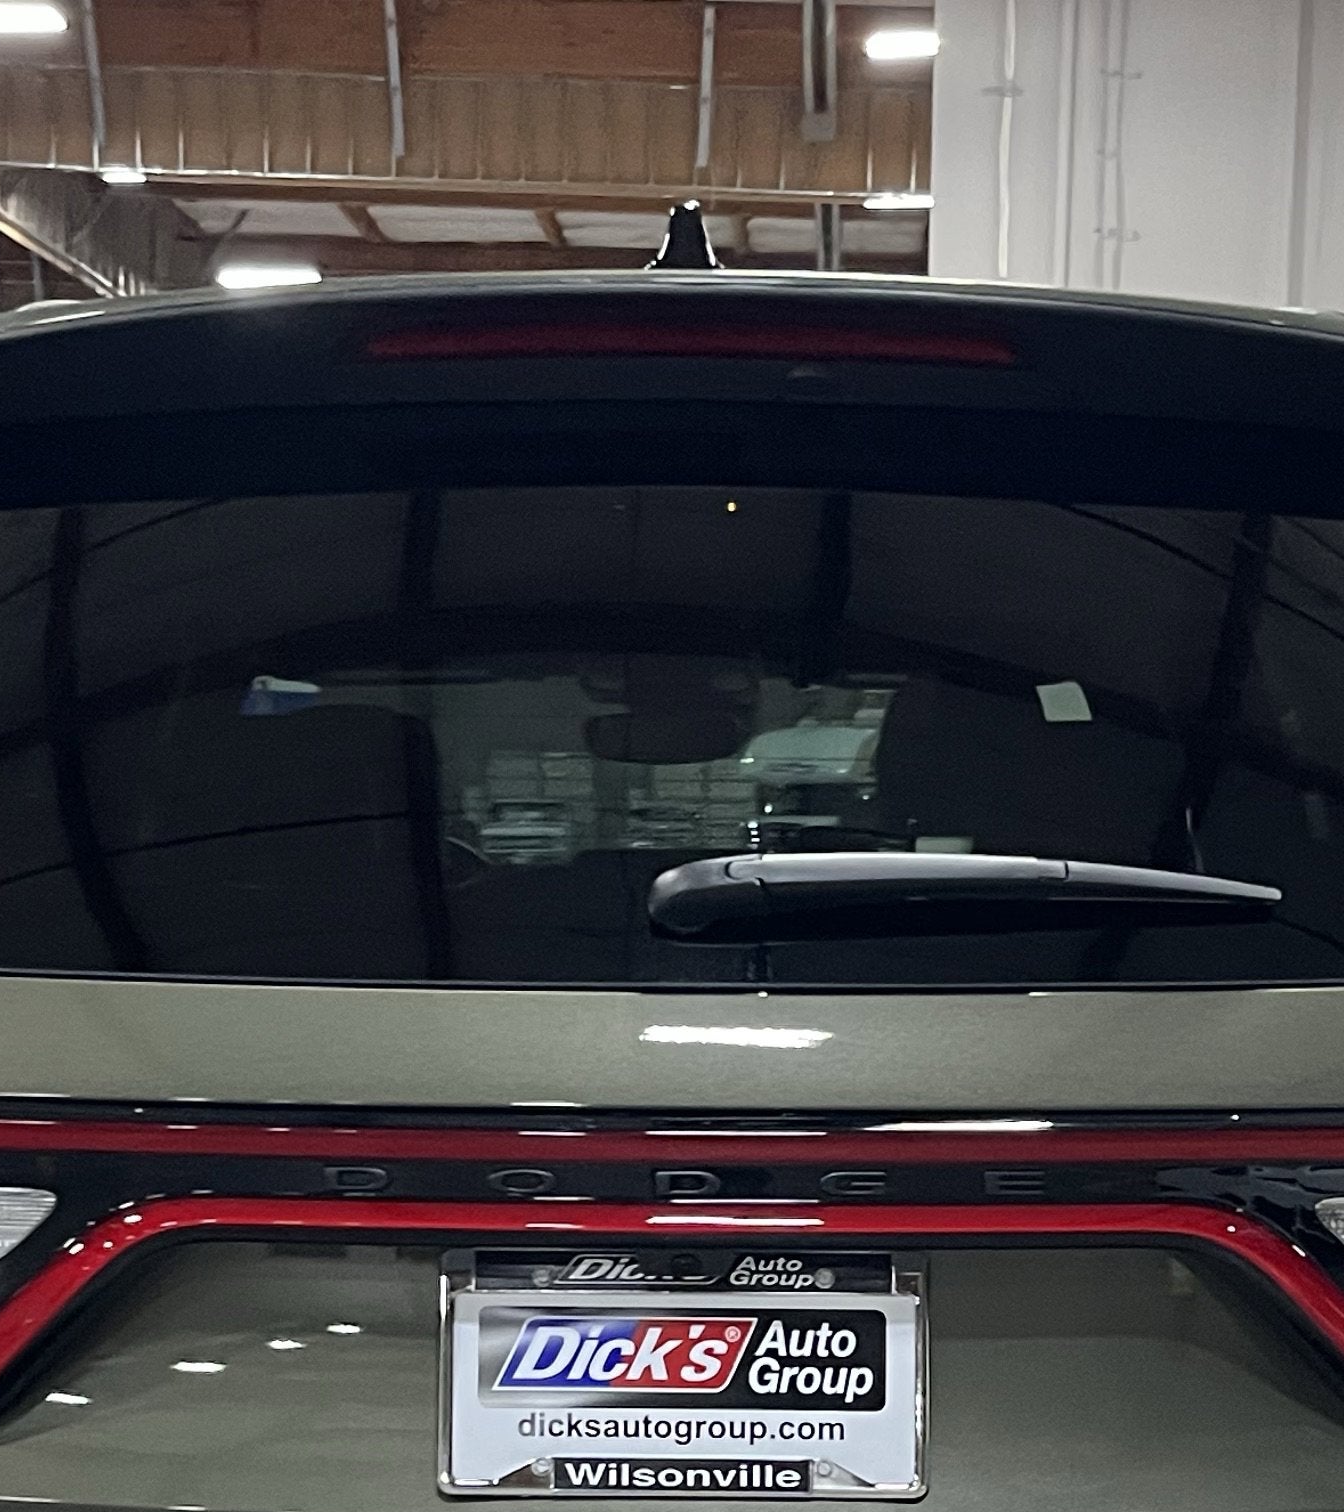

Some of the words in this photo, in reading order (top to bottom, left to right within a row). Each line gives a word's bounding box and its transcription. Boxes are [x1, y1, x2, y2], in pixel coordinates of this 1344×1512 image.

[323, 1166, 1045, 1196] DODGE
[730, 1270, 814, 1289] Group
[736, 1256, 803, 1272] Auto
[512, 1324, 729, 1382] Dick's
[755, 1320, 857, 1358] Auto
[748, 1358, 875, 1402] Group
[518, 1413, 846, 1445] dicksautogroup.com
[565, 1463, 802, 1488] Wilsonville
